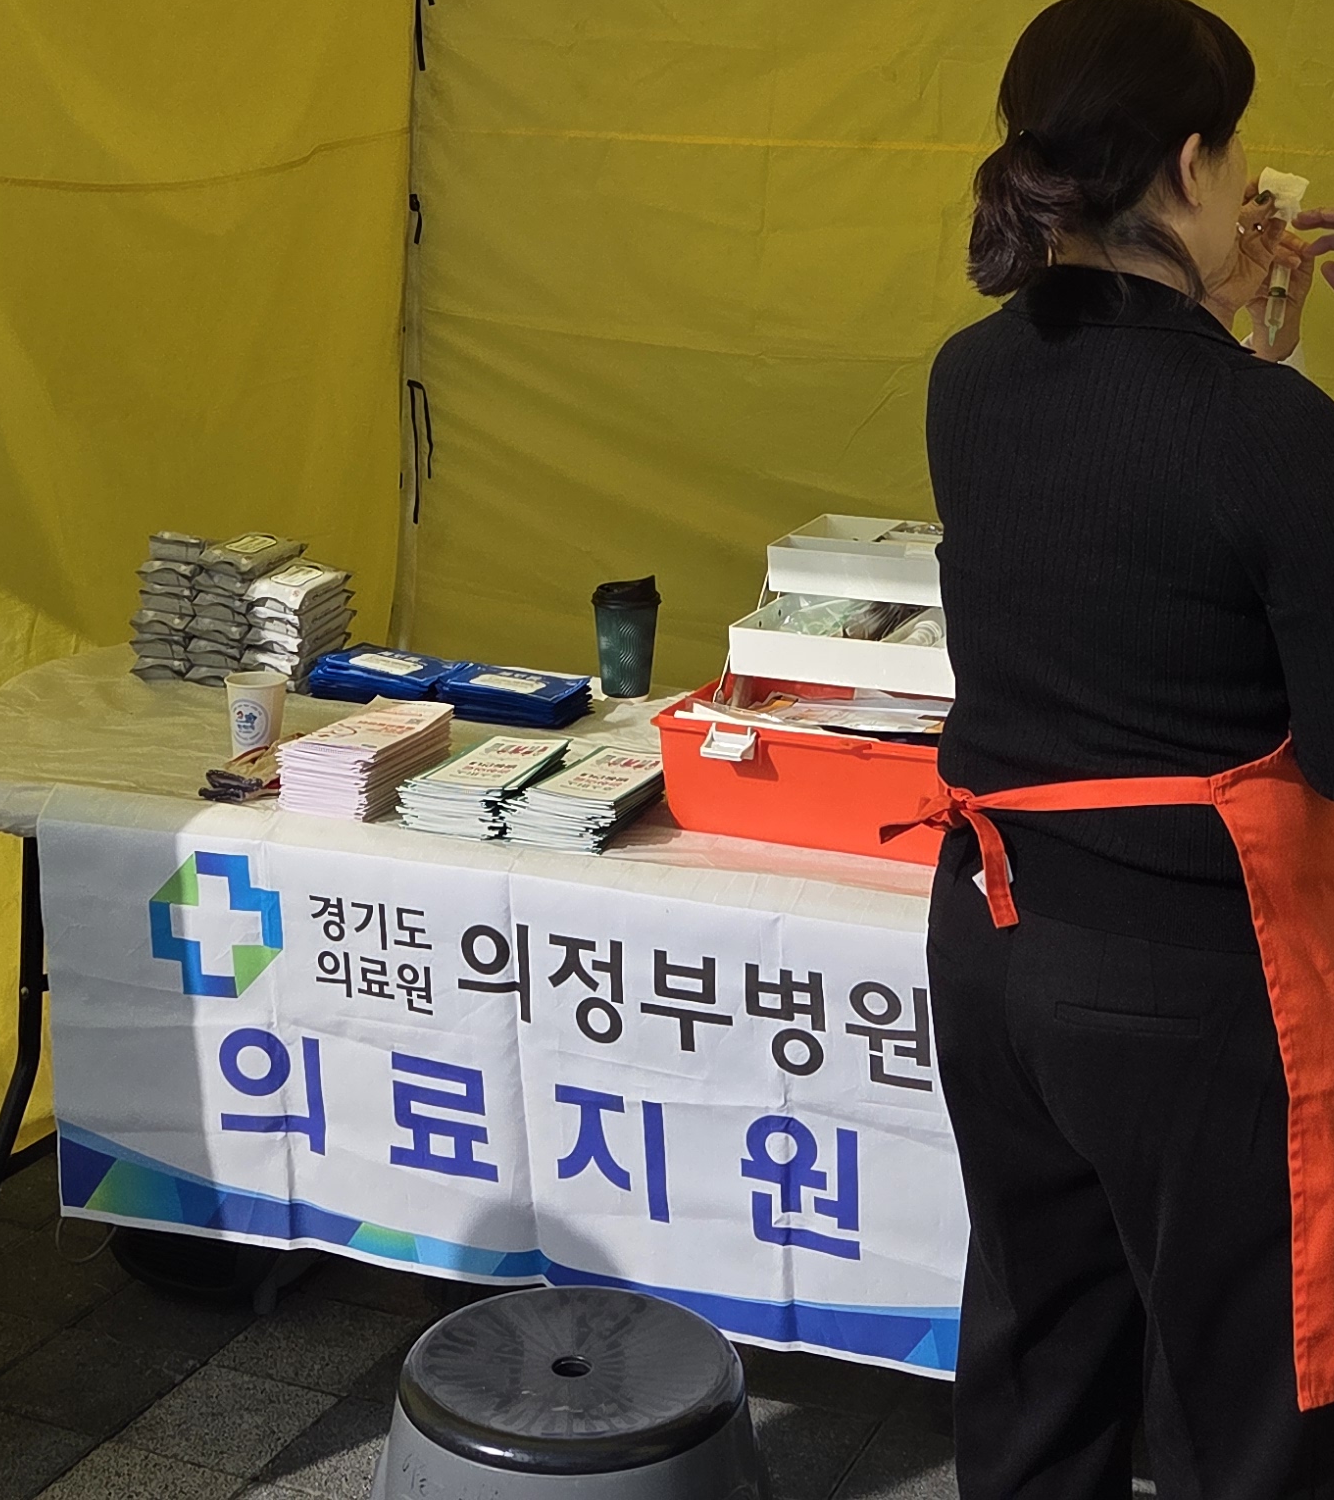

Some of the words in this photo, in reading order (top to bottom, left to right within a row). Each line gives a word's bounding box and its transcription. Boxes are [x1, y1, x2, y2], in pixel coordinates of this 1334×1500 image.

[309, 894, 433, 951] 경기도
[316, 950, 434, 1016] 의료원
[458, 924, 933, 1092] 의정부병원
[218, 1028, 861, 1260] 의료지원
